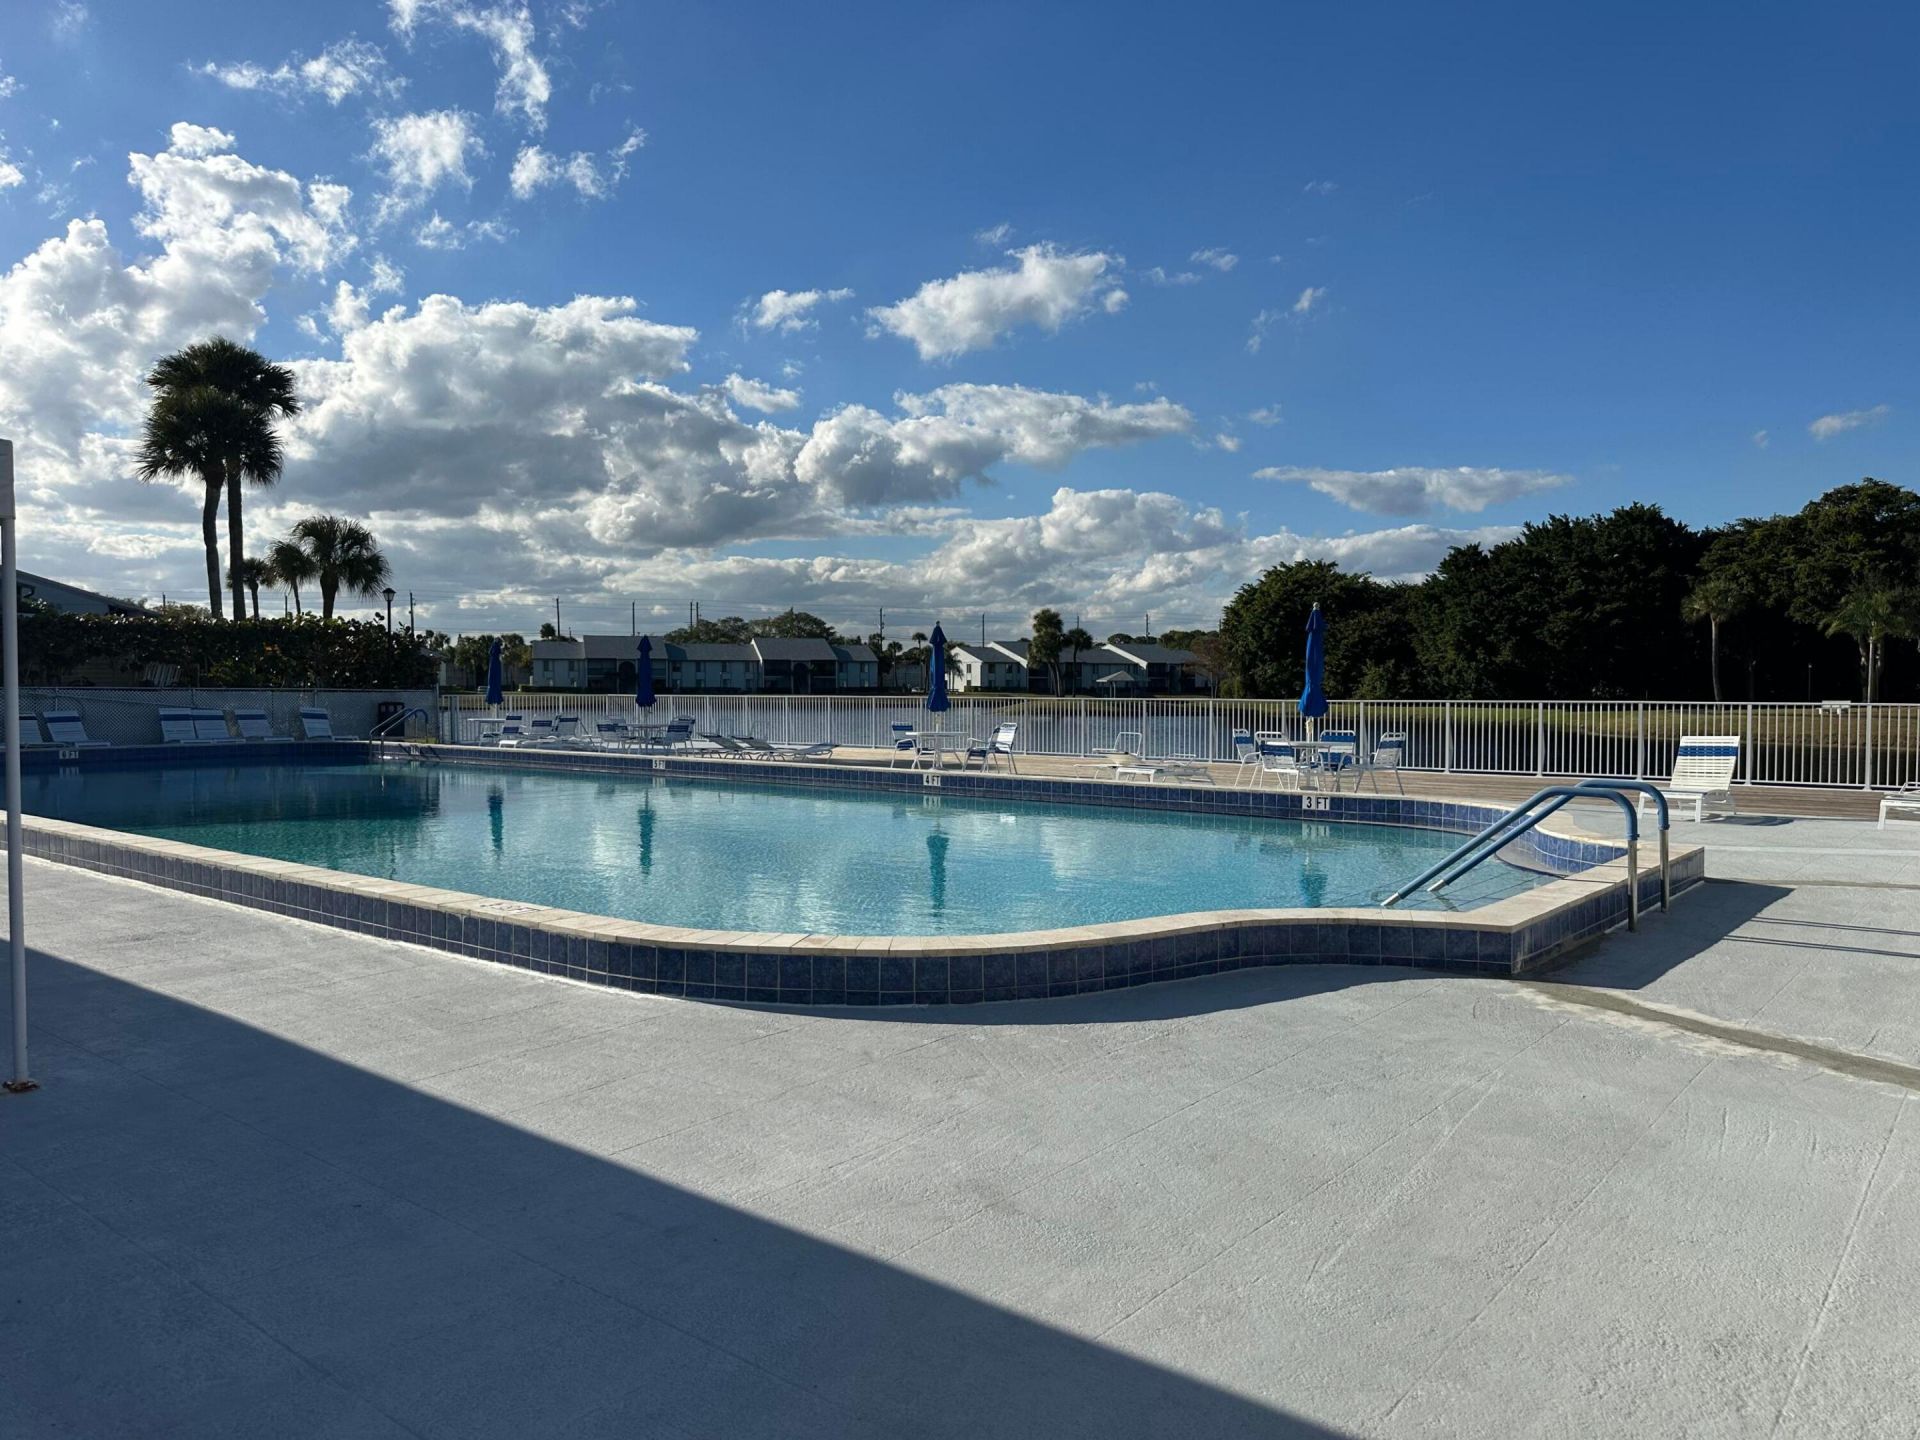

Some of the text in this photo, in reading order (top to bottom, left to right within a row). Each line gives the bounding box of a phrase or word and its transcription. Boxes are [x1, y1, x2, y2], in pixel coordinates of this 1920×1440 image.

[925, 774, 940, 786] 4 FT
[1306, 796, 1329, 810] 3 FT
